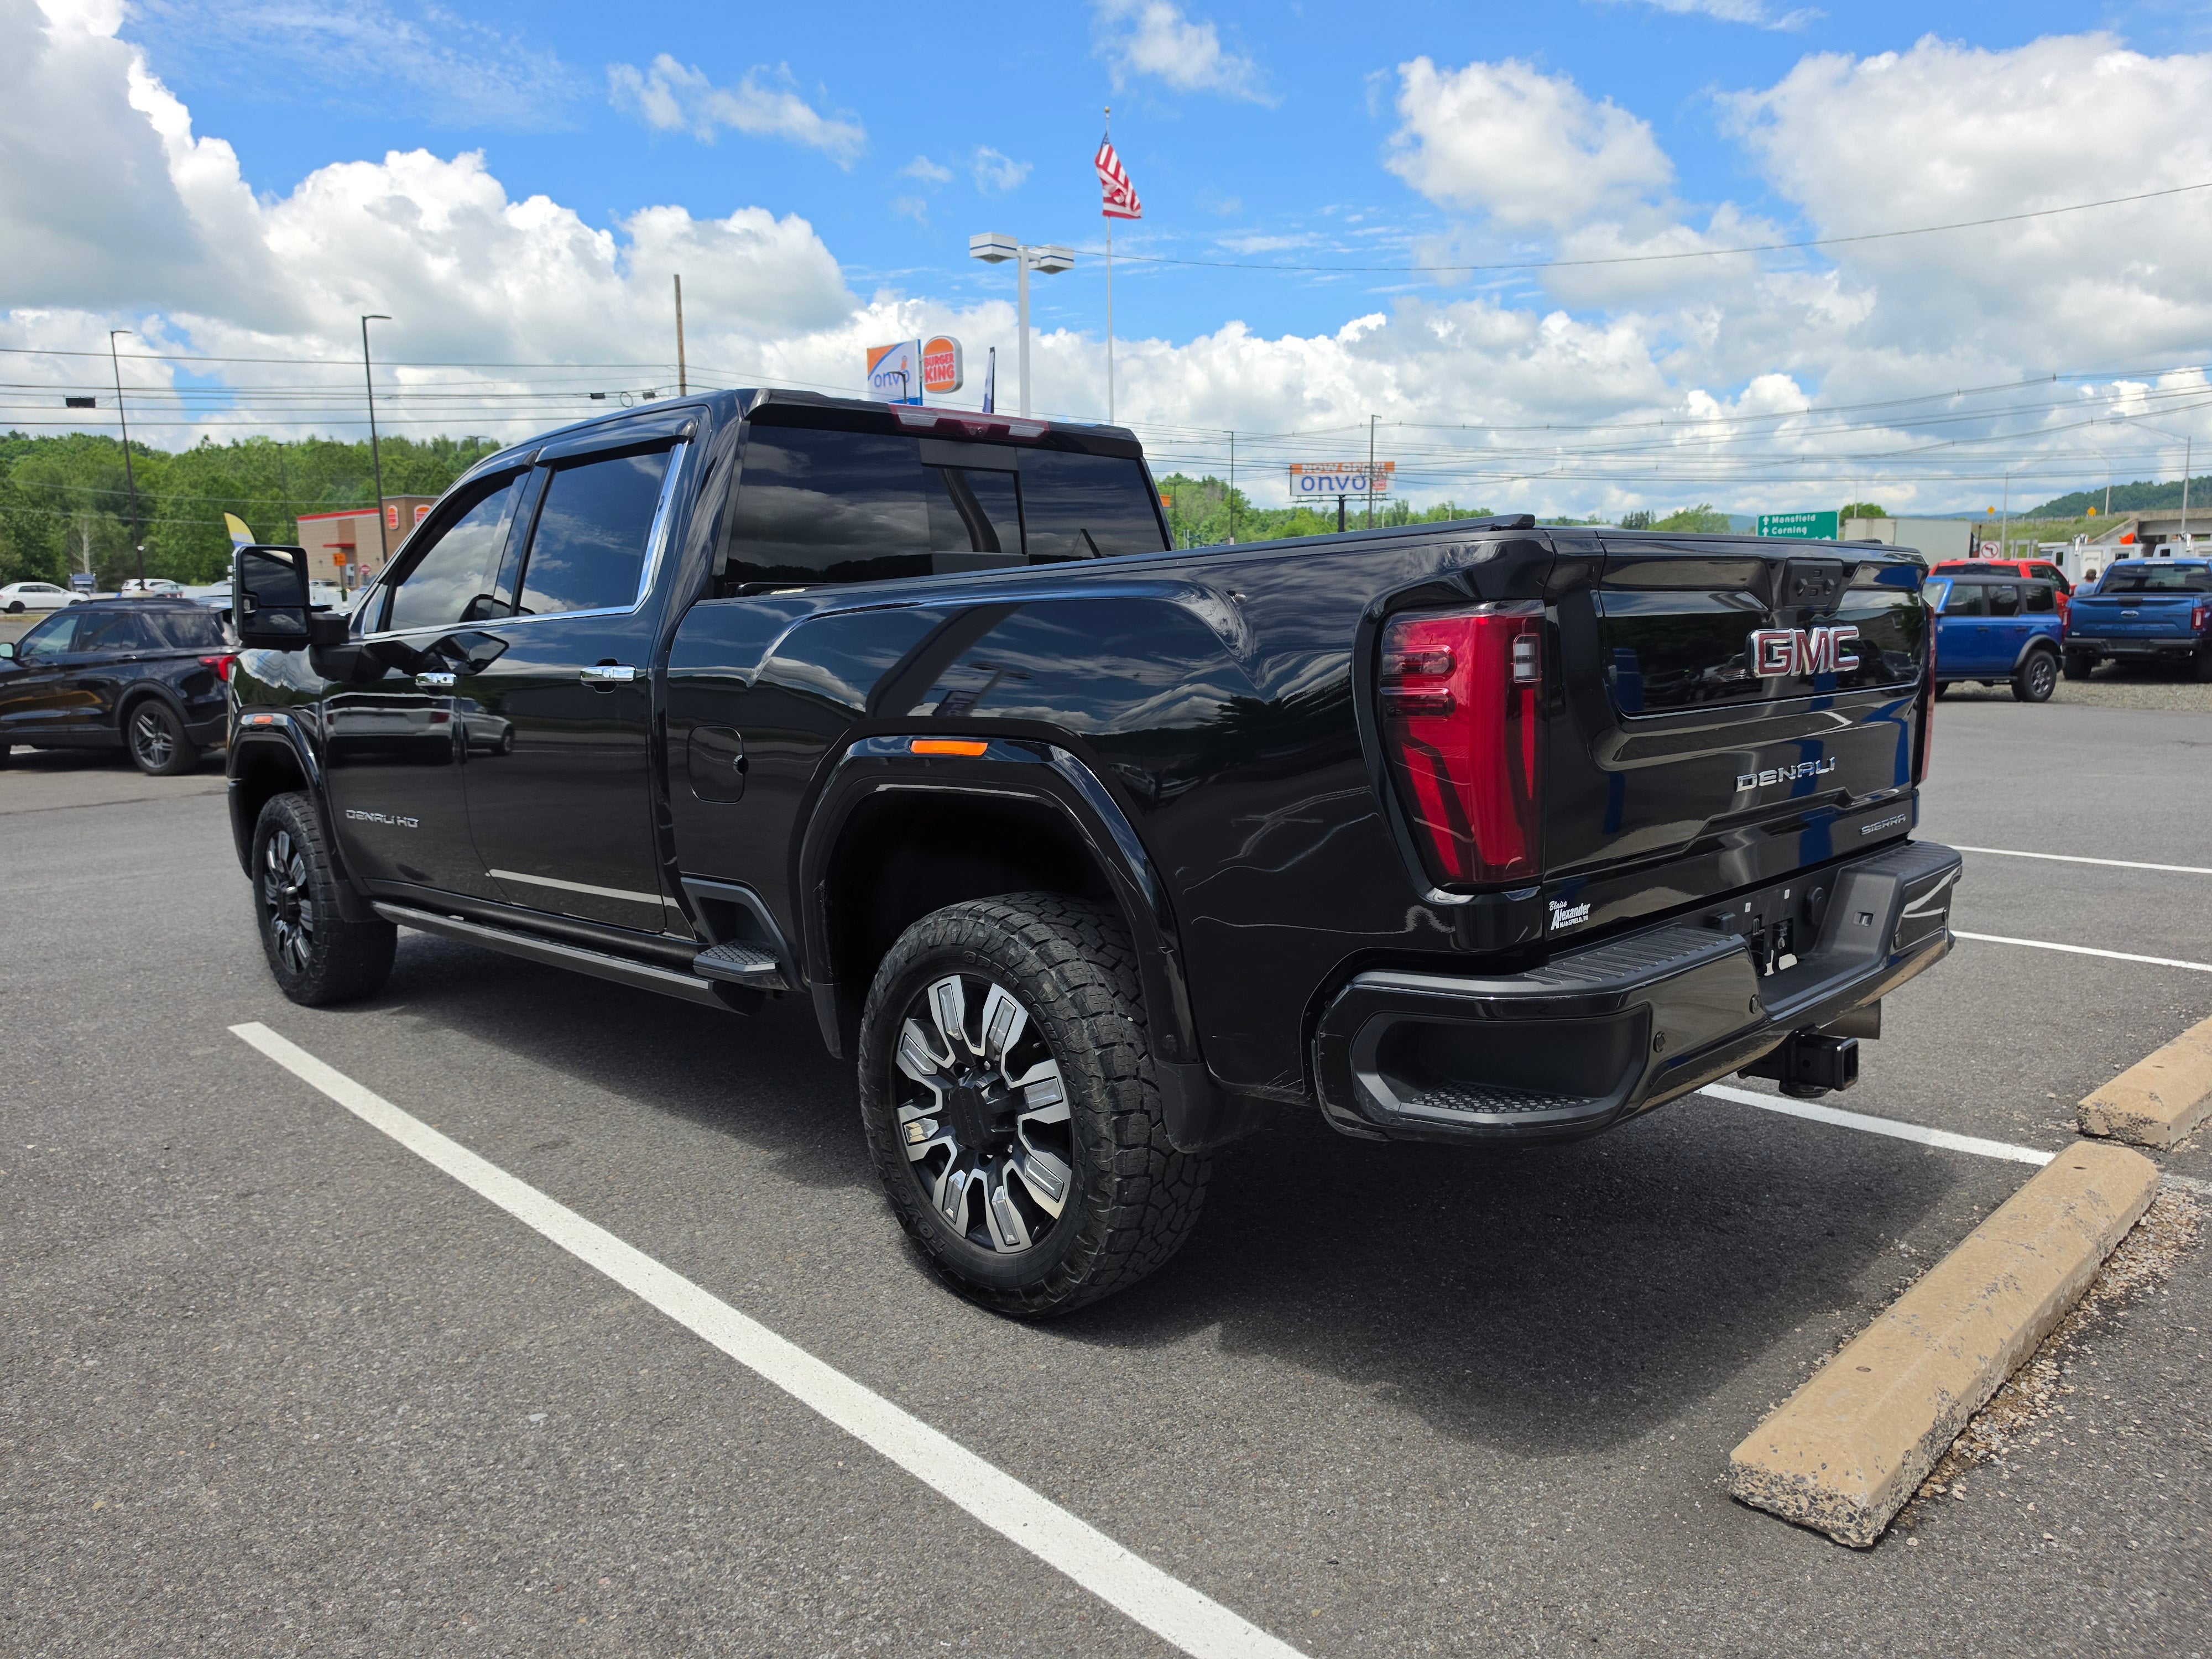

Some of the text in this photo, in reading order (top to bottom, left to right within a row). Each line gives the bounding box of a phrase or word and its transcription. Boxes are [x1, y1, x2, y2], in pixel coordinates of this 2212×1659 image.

[925, 352, 954, 368] BURGER
[874, 369, 910, 388] onvo
[925, 363, 955, 383] KING
[1302, 463, 1339, 473] NOW
[1301, 475, 1366, 491] onvo
[1772, 514, 1816, 524] Mansfield
[1771, 526, 1807, 535] Corning
[1750, 625, 1859, 678] GMC
[1735, 757, 1835, 792] DENALI
[345, 810, 419, 828] DENALI HD
[1861, 813, 1907, 836] SIERRA
[1549, 900, 1567, 911] Blaise
[1550, 902, 1591, 931] Alexander
[1559, 916, 1583, 928] MANSFIELD,
[963, 951, 1020, 988] OPEN
[896, 1186, 946, 1254] TOYO
